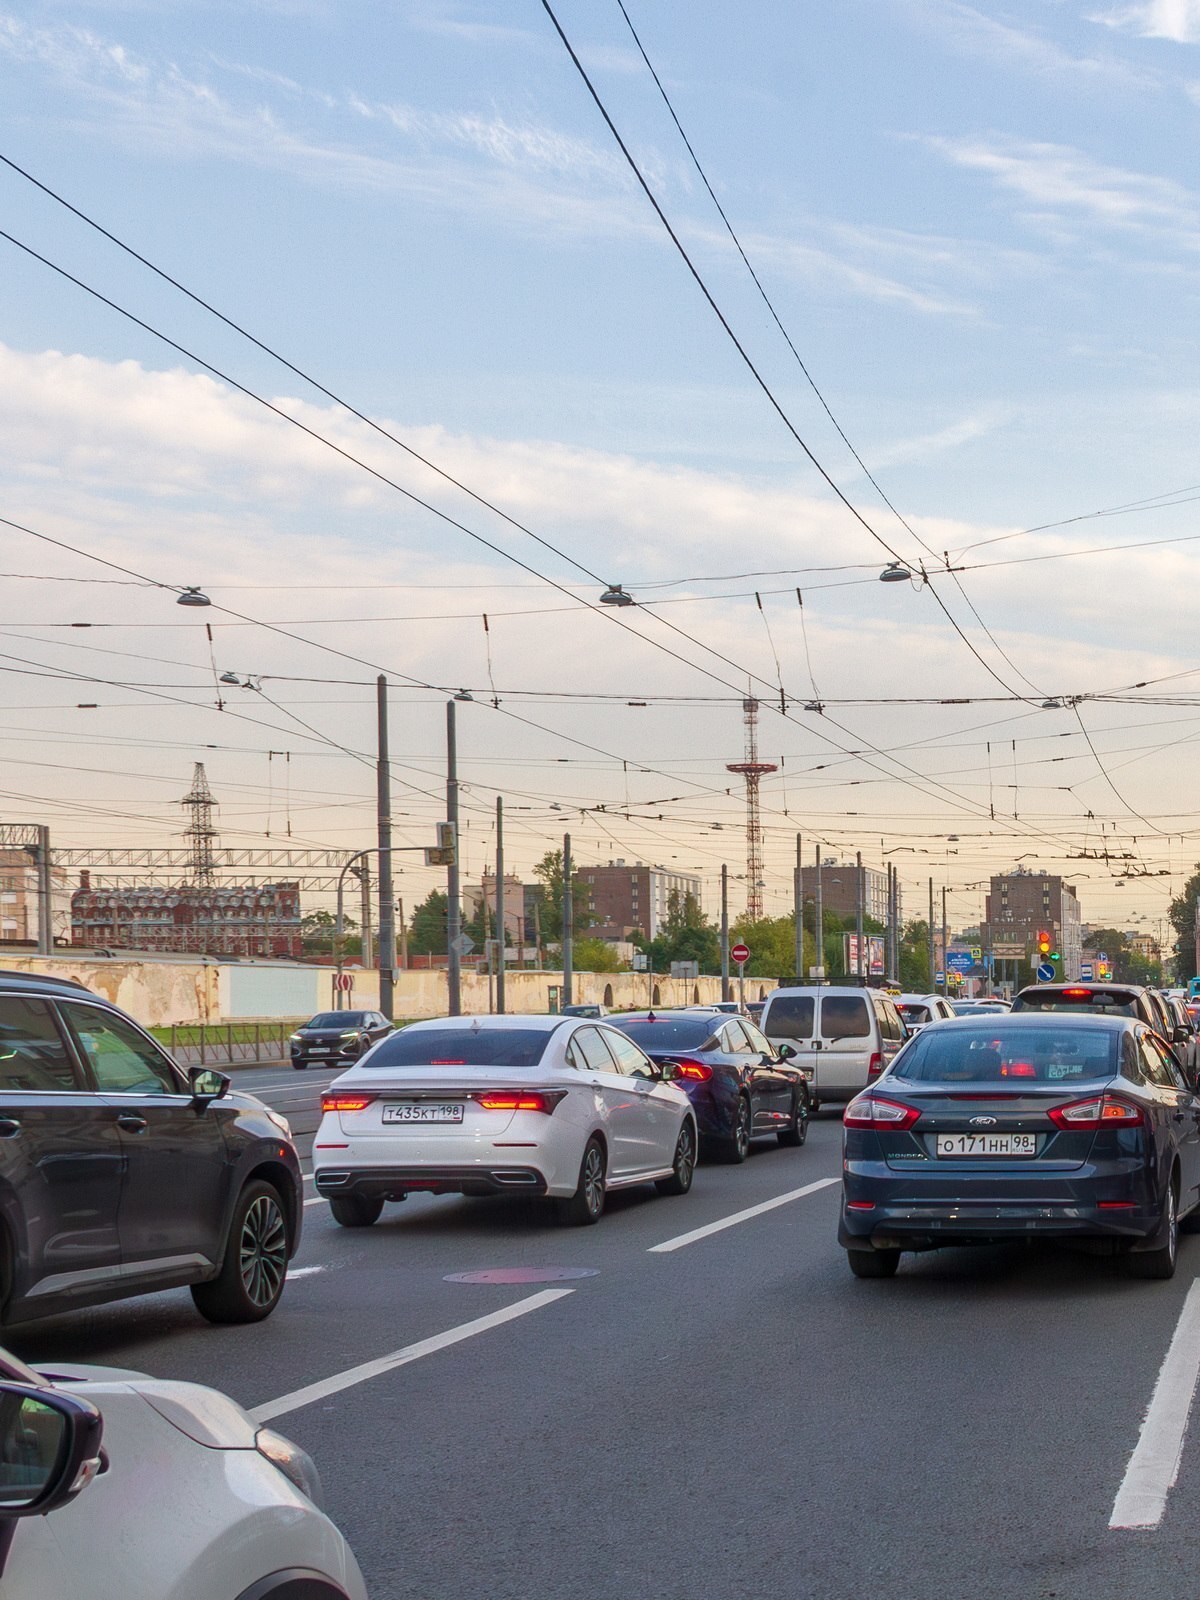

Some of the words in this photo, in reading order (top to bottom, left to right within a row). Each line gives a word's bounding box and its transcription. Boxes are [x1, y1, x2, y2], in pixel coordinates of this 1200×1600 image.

[387, 1106, 438, 1119] Т435КТ
[440, 1106, 459, 1116] 198
[1013, 1135, 1030, 1148] 98
